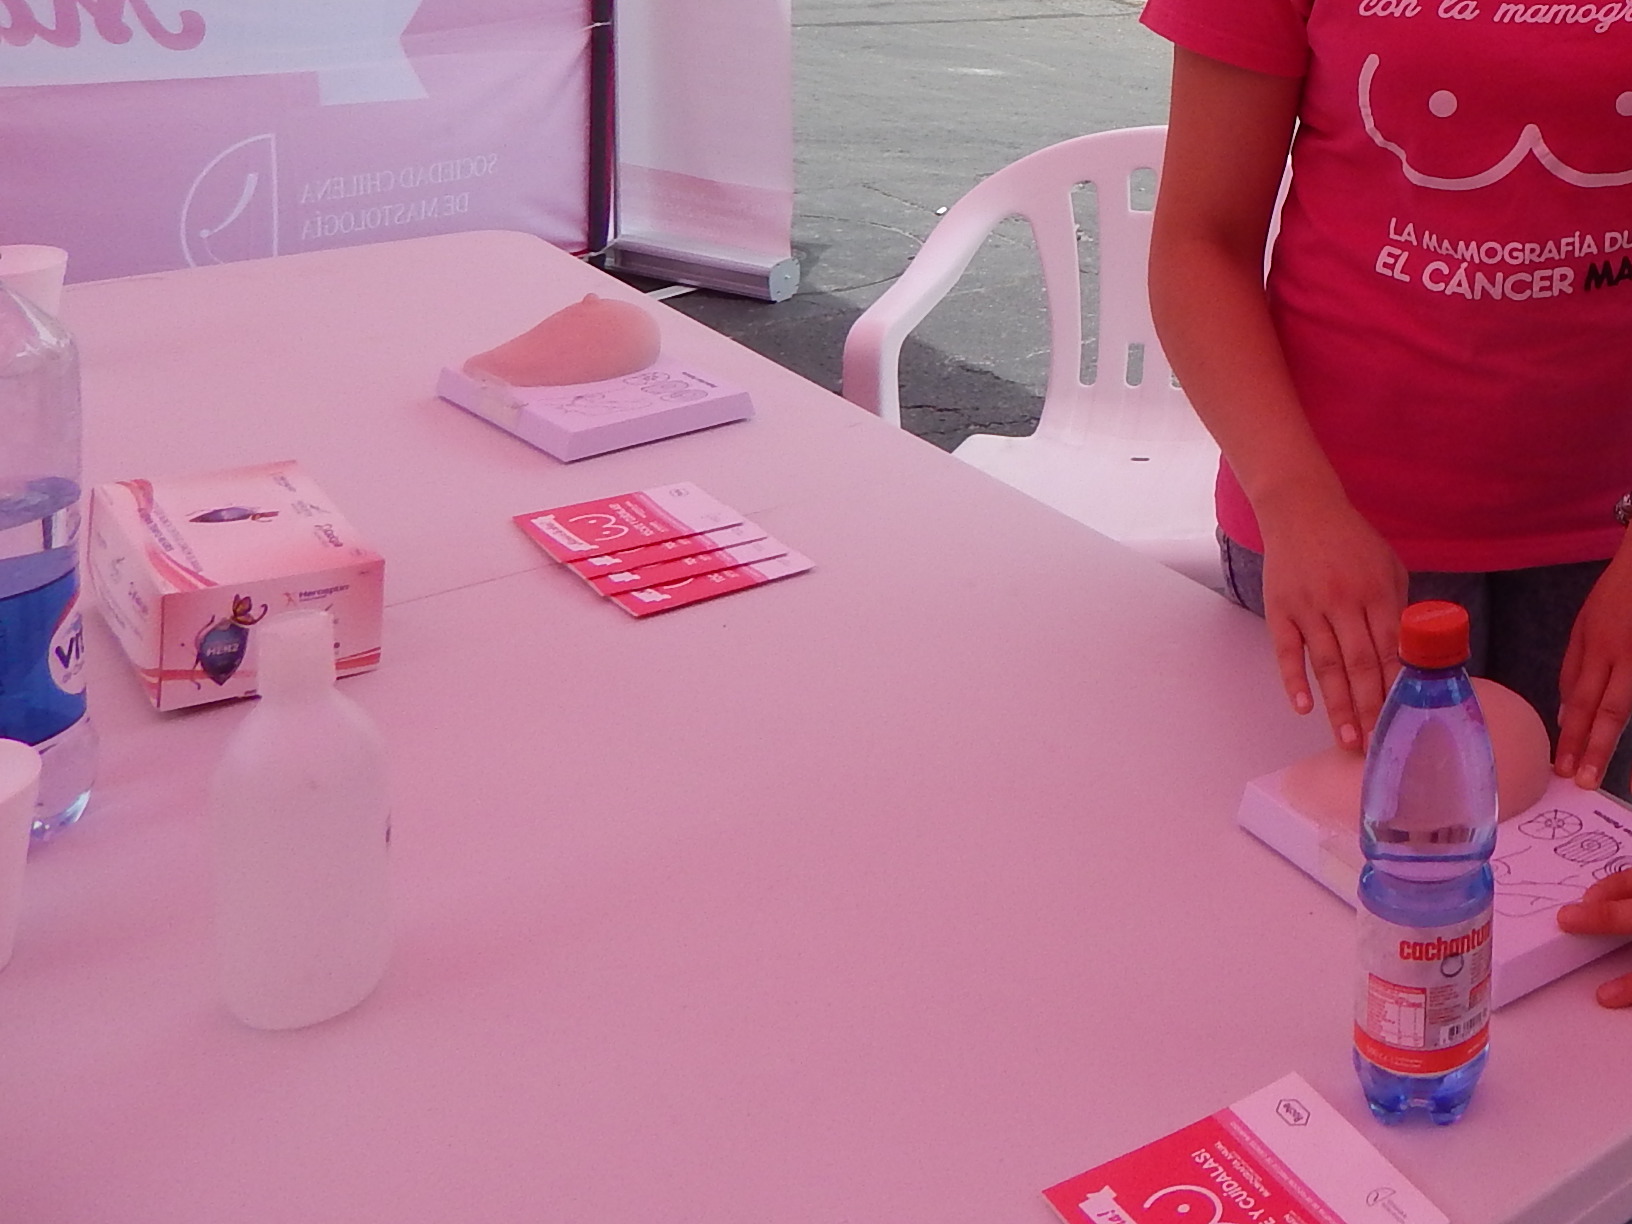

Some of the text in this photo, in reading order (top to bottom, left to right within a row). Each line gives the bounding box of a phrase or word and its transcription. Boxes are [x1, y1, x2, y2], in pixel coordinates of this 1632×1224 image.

[1388, 216, 1418, 247] LA
[1422, 229, 1598, 266] MAMOGRAFÍA
[1374, 244, 1411, 283] EL
[1421, 260, 1576, 302] CÁNCER
[1190, 1147, 1256, 1210] CUÍDALAS!
